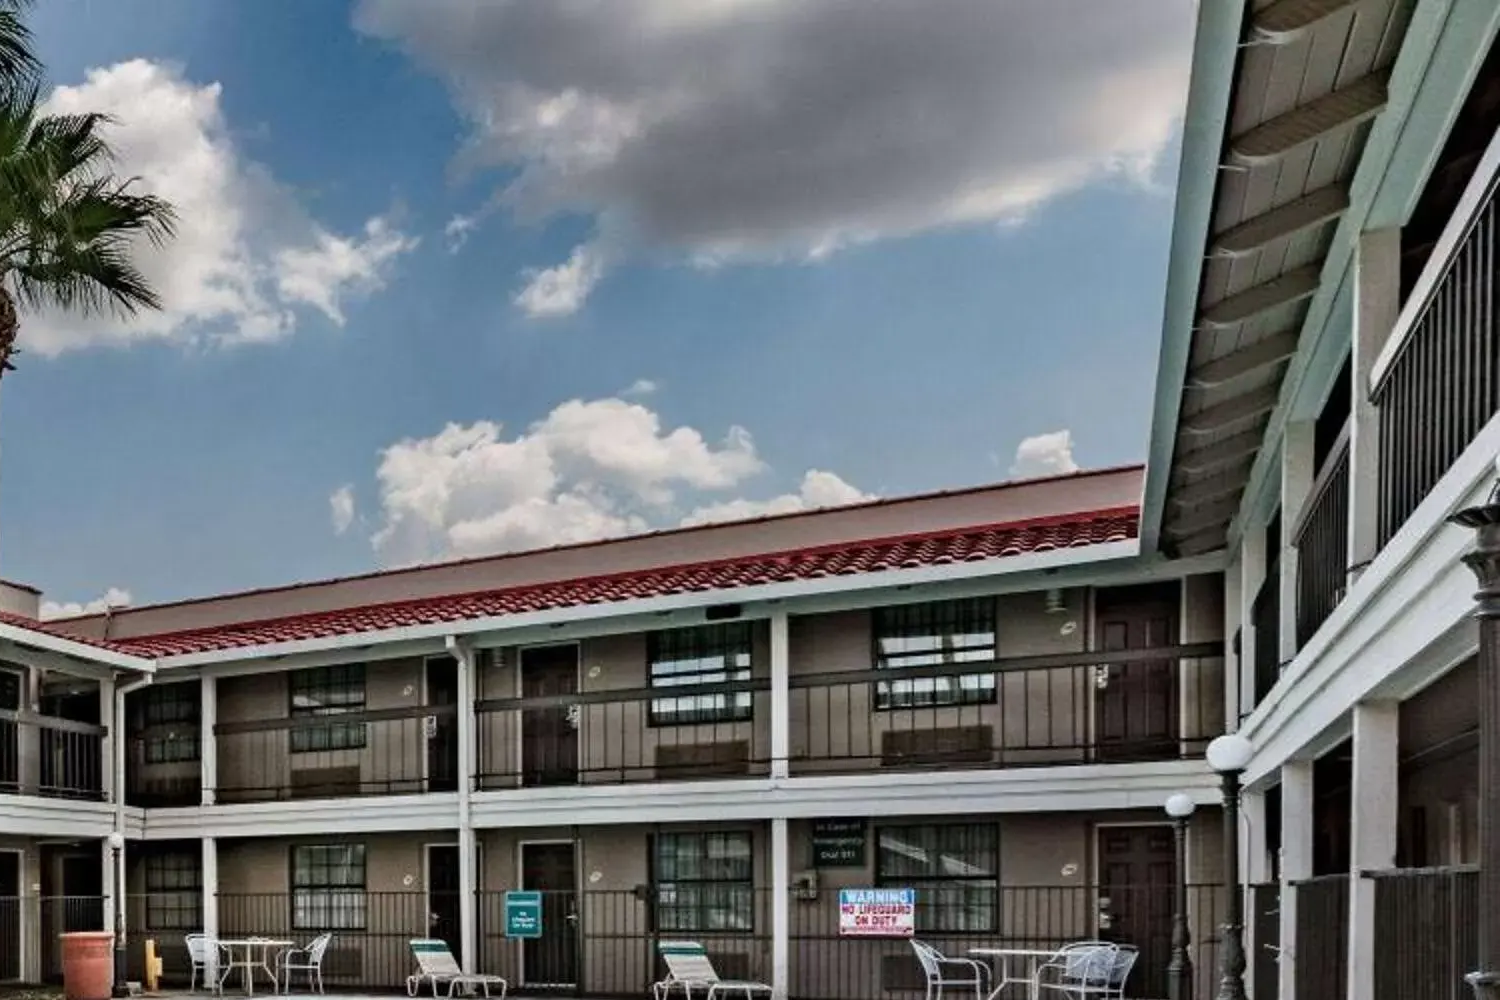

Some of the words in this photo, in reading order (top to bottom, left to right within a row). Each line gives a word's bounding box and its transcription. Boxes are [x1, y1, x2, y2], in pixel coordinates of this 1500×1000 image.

[845, 891, 907, 904] WARNING
[842, 905, 855, 915] NO
[859, 905, 911, 915] LIFEGUARD
[855, 915, 869, 926] ON
[872, 915, 897, 926] DUTY
